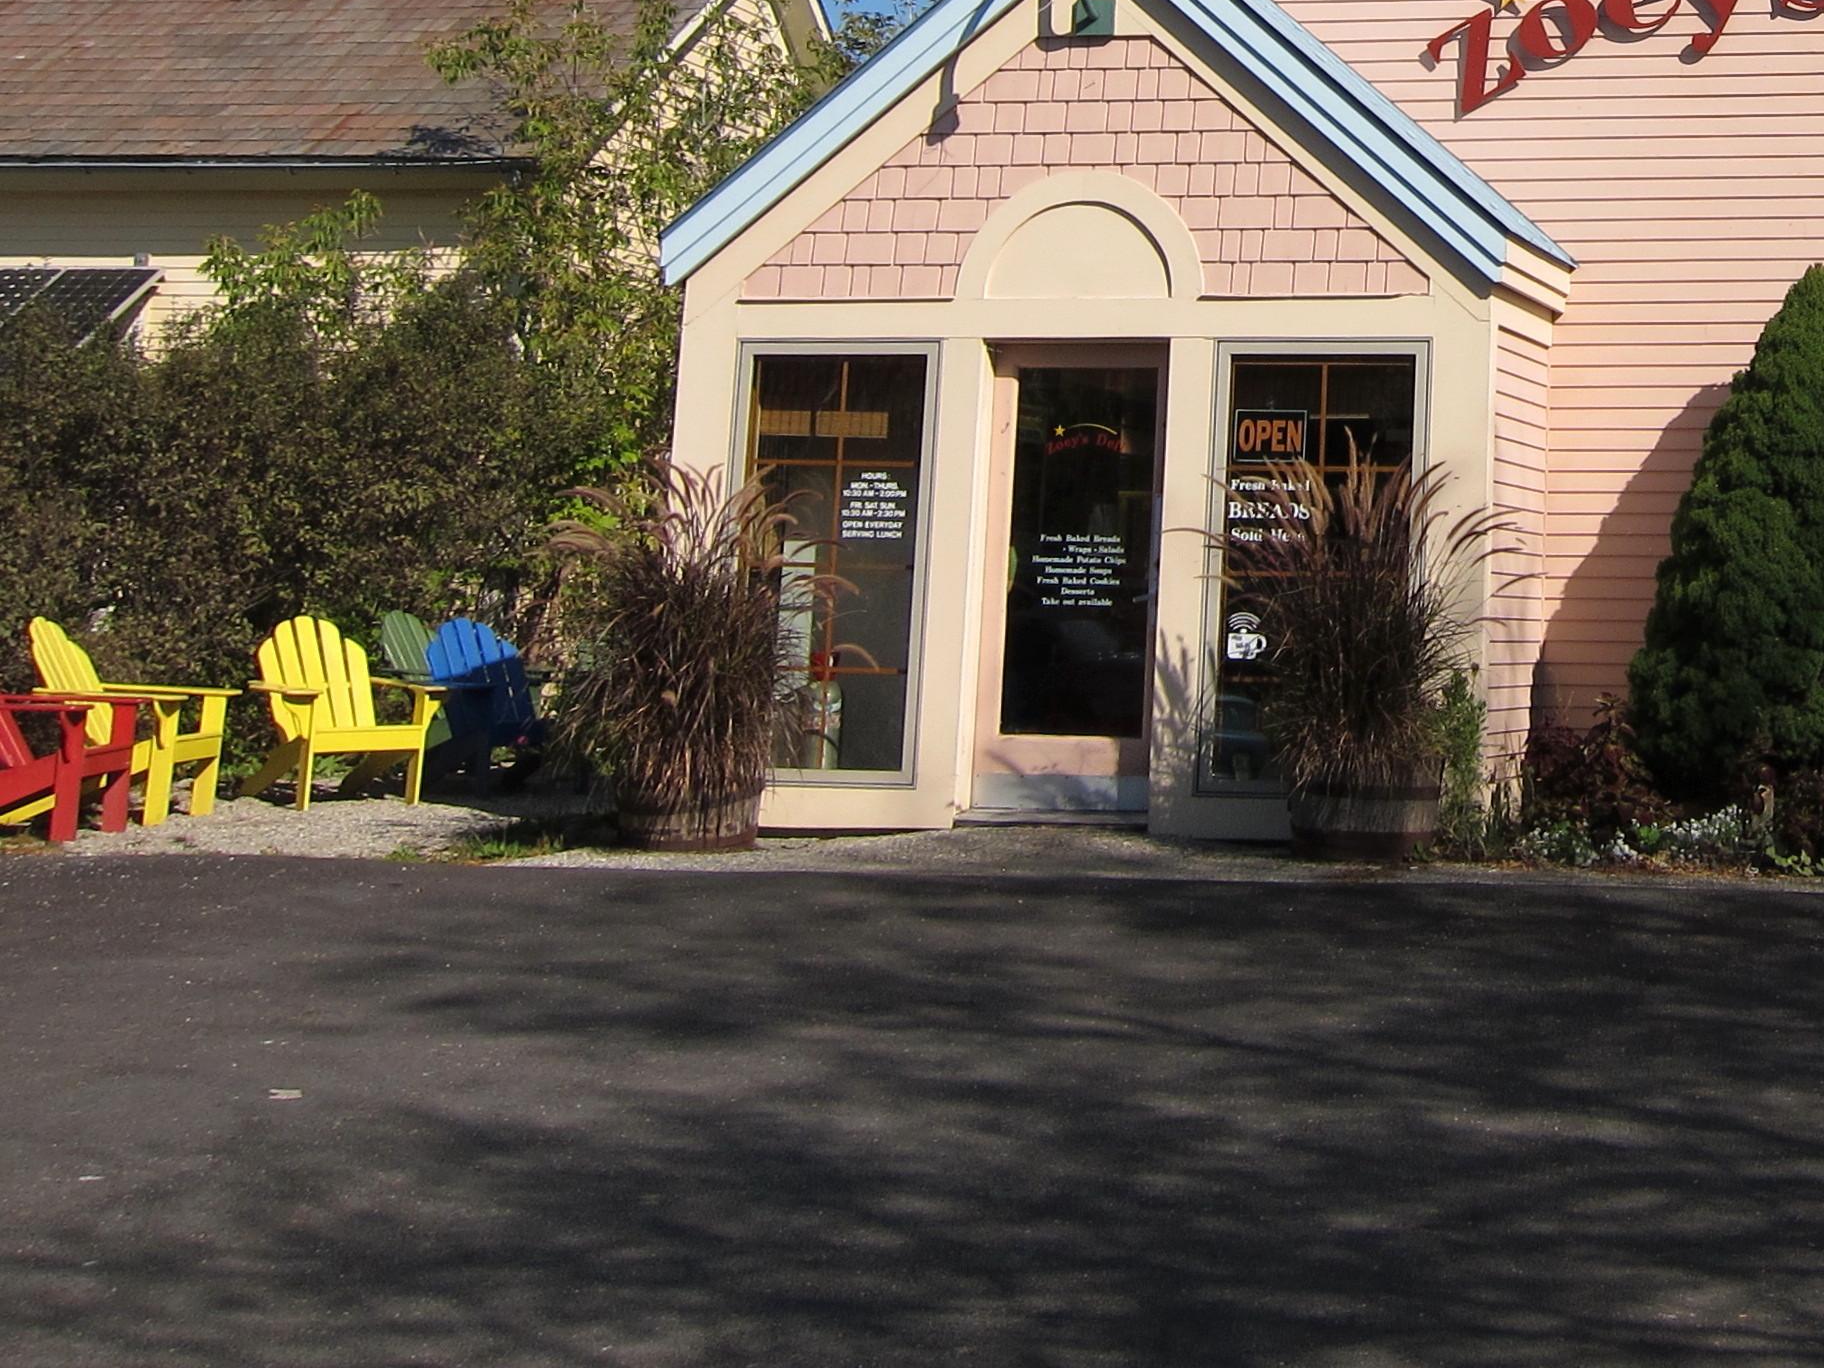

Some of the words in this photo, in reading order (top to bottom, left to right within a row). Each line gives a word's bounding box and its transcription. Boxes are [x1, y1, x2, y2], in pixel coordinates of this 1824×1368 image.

[1238, 418, 1303, 452] OPEN
[842, 520, 863, 529] OPEN
[865, 521, 903, 529] EVERYDAY
[842, 530, 875, 538] SERVING
[876, 531, 902, 539] LUNCH
[1040, 534, 1062, 542] Fresh
[1066, 534, 1090, 543] Baked
[1093, 534, 1121, 543] Breads
[1032, 555, 1074, 563] Homemade
[1077, 555, 1102, 564] Potato
[1104, 556, 1127, 566] Chips
[1045, 565, 1087, 574] Homemade
[1037, 576, 1059, 584] Fresh
[1062, 576, 1087, 585] Baked
[1089, 577, 1120, 585] Cookies
[1060, 587, 1095, 595] Desserts
[1041, 597, 1060, 605] Take
[1078, 597, 1113, 606] available
